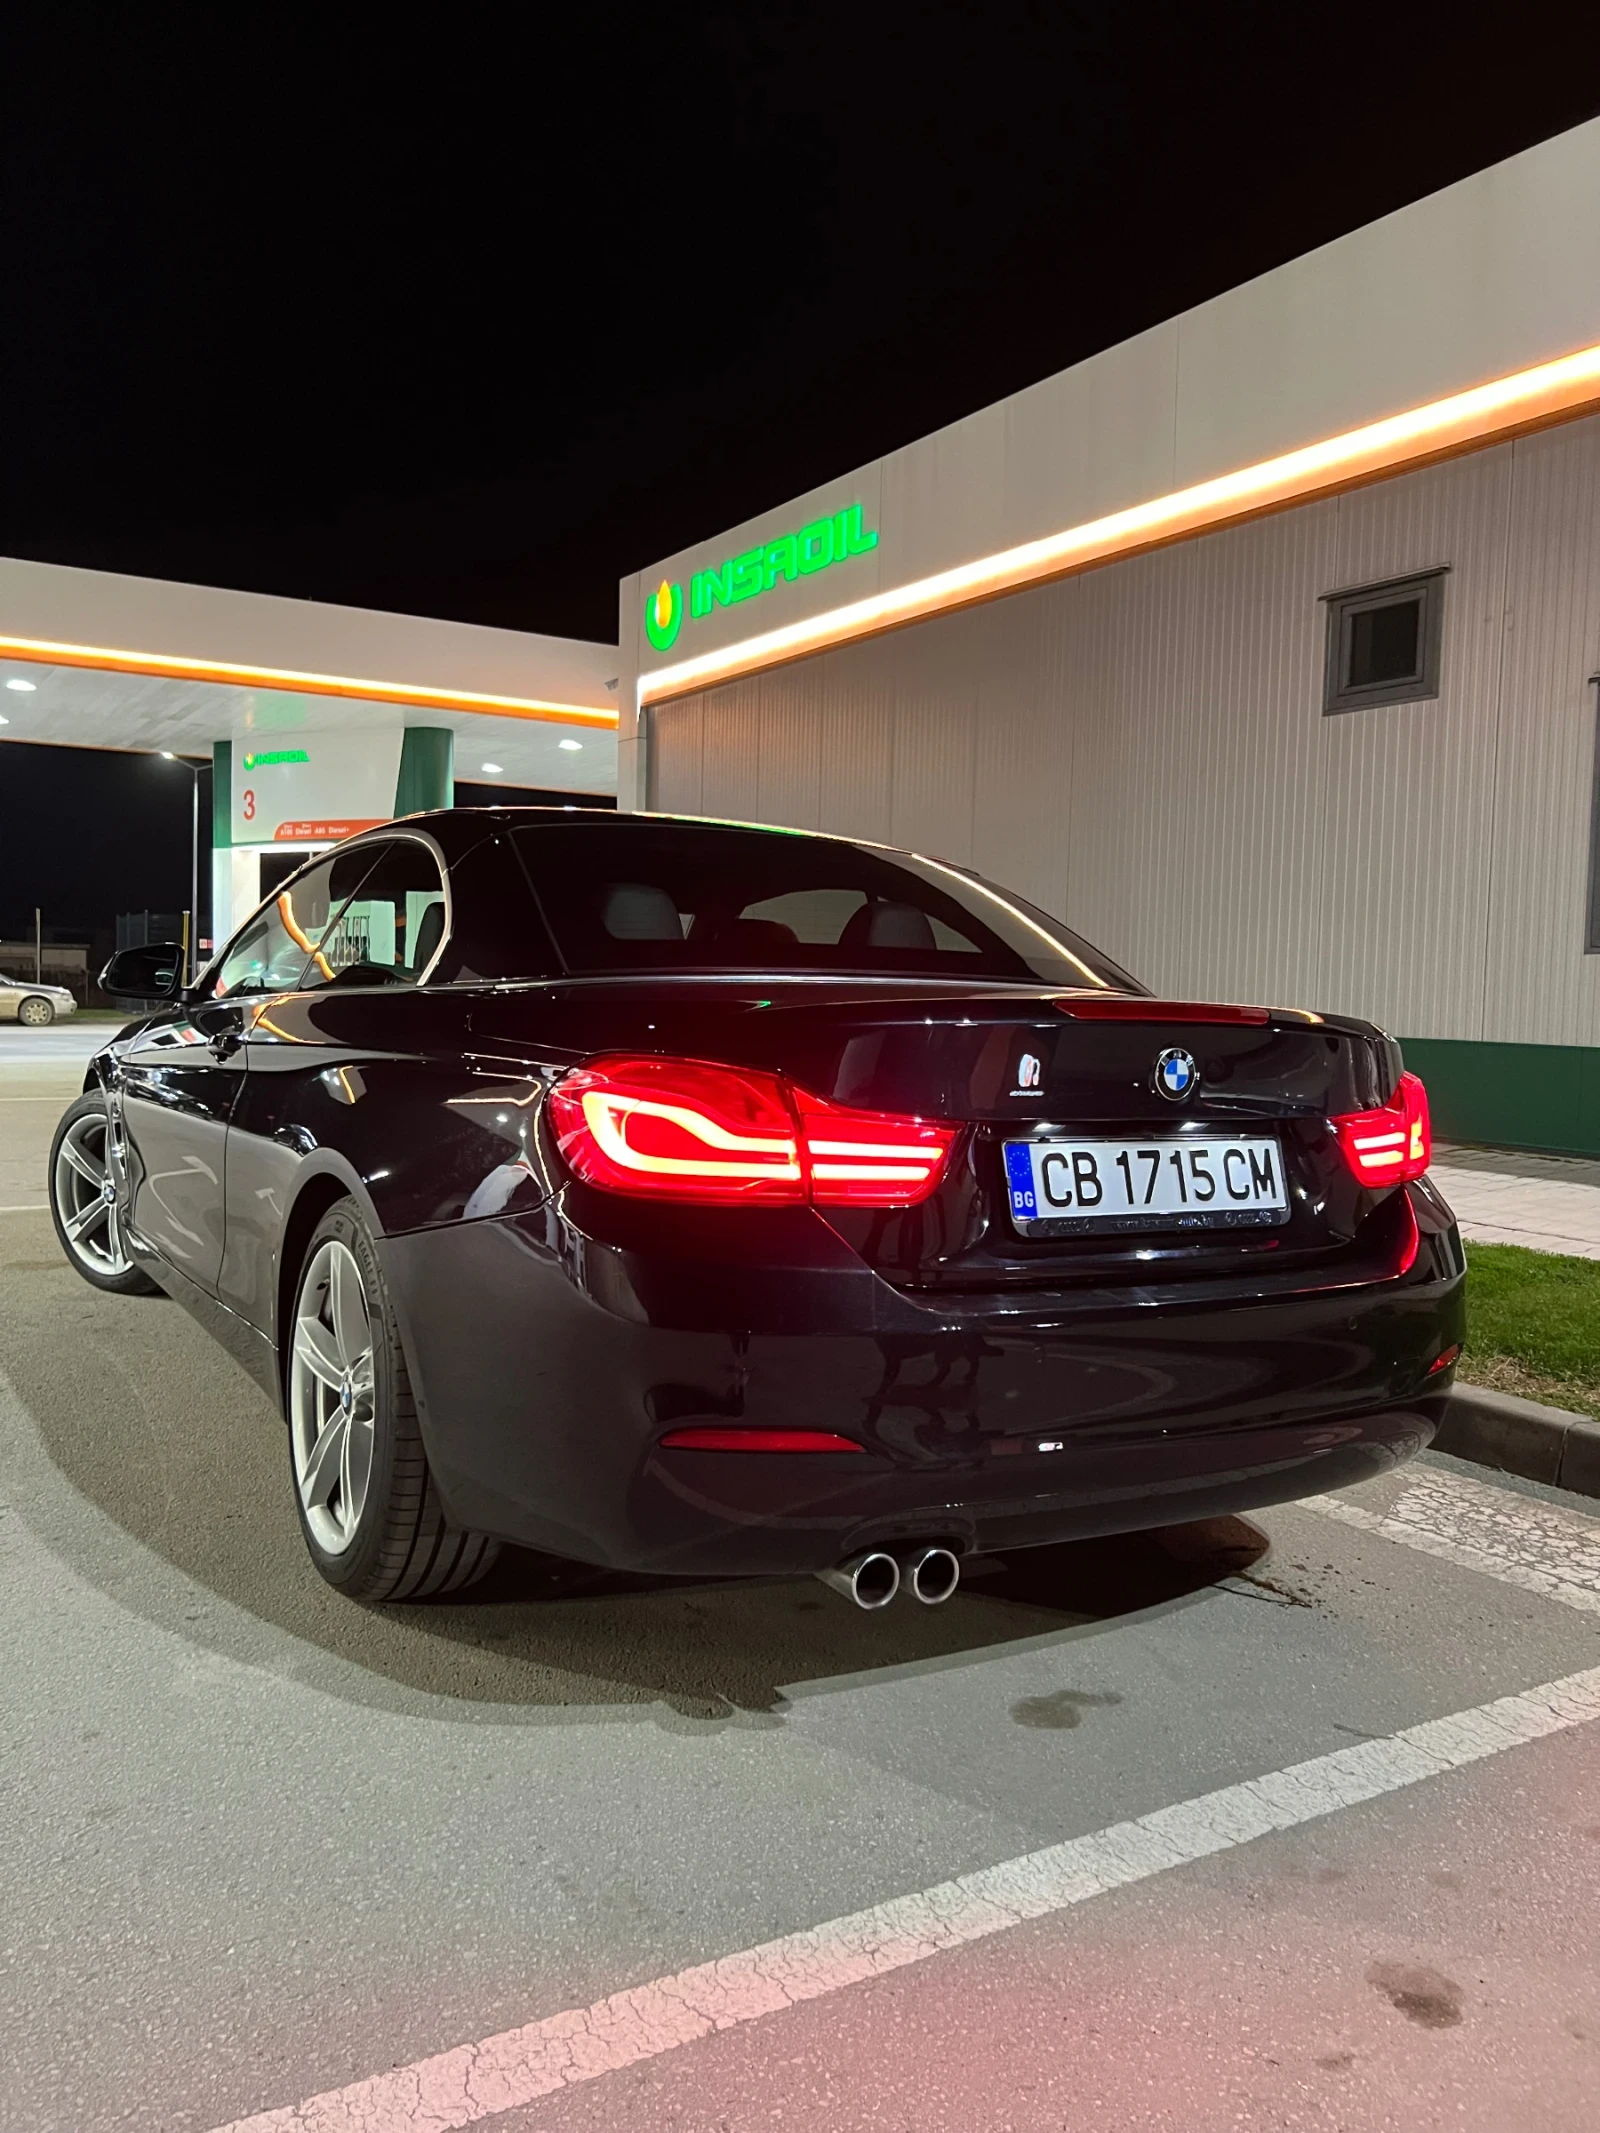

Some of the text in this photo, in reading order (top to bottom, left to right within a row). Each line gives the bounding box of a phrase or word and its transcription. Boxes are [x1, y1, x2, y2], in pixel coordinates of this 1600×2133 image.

[691, 504, 878, 617] INSAOIL
[243, 789, 256, 821] 3
[1013, 1191, 1035, 1209] BG
[1041, 1148, 1277, 1208] CB 1715 CM
